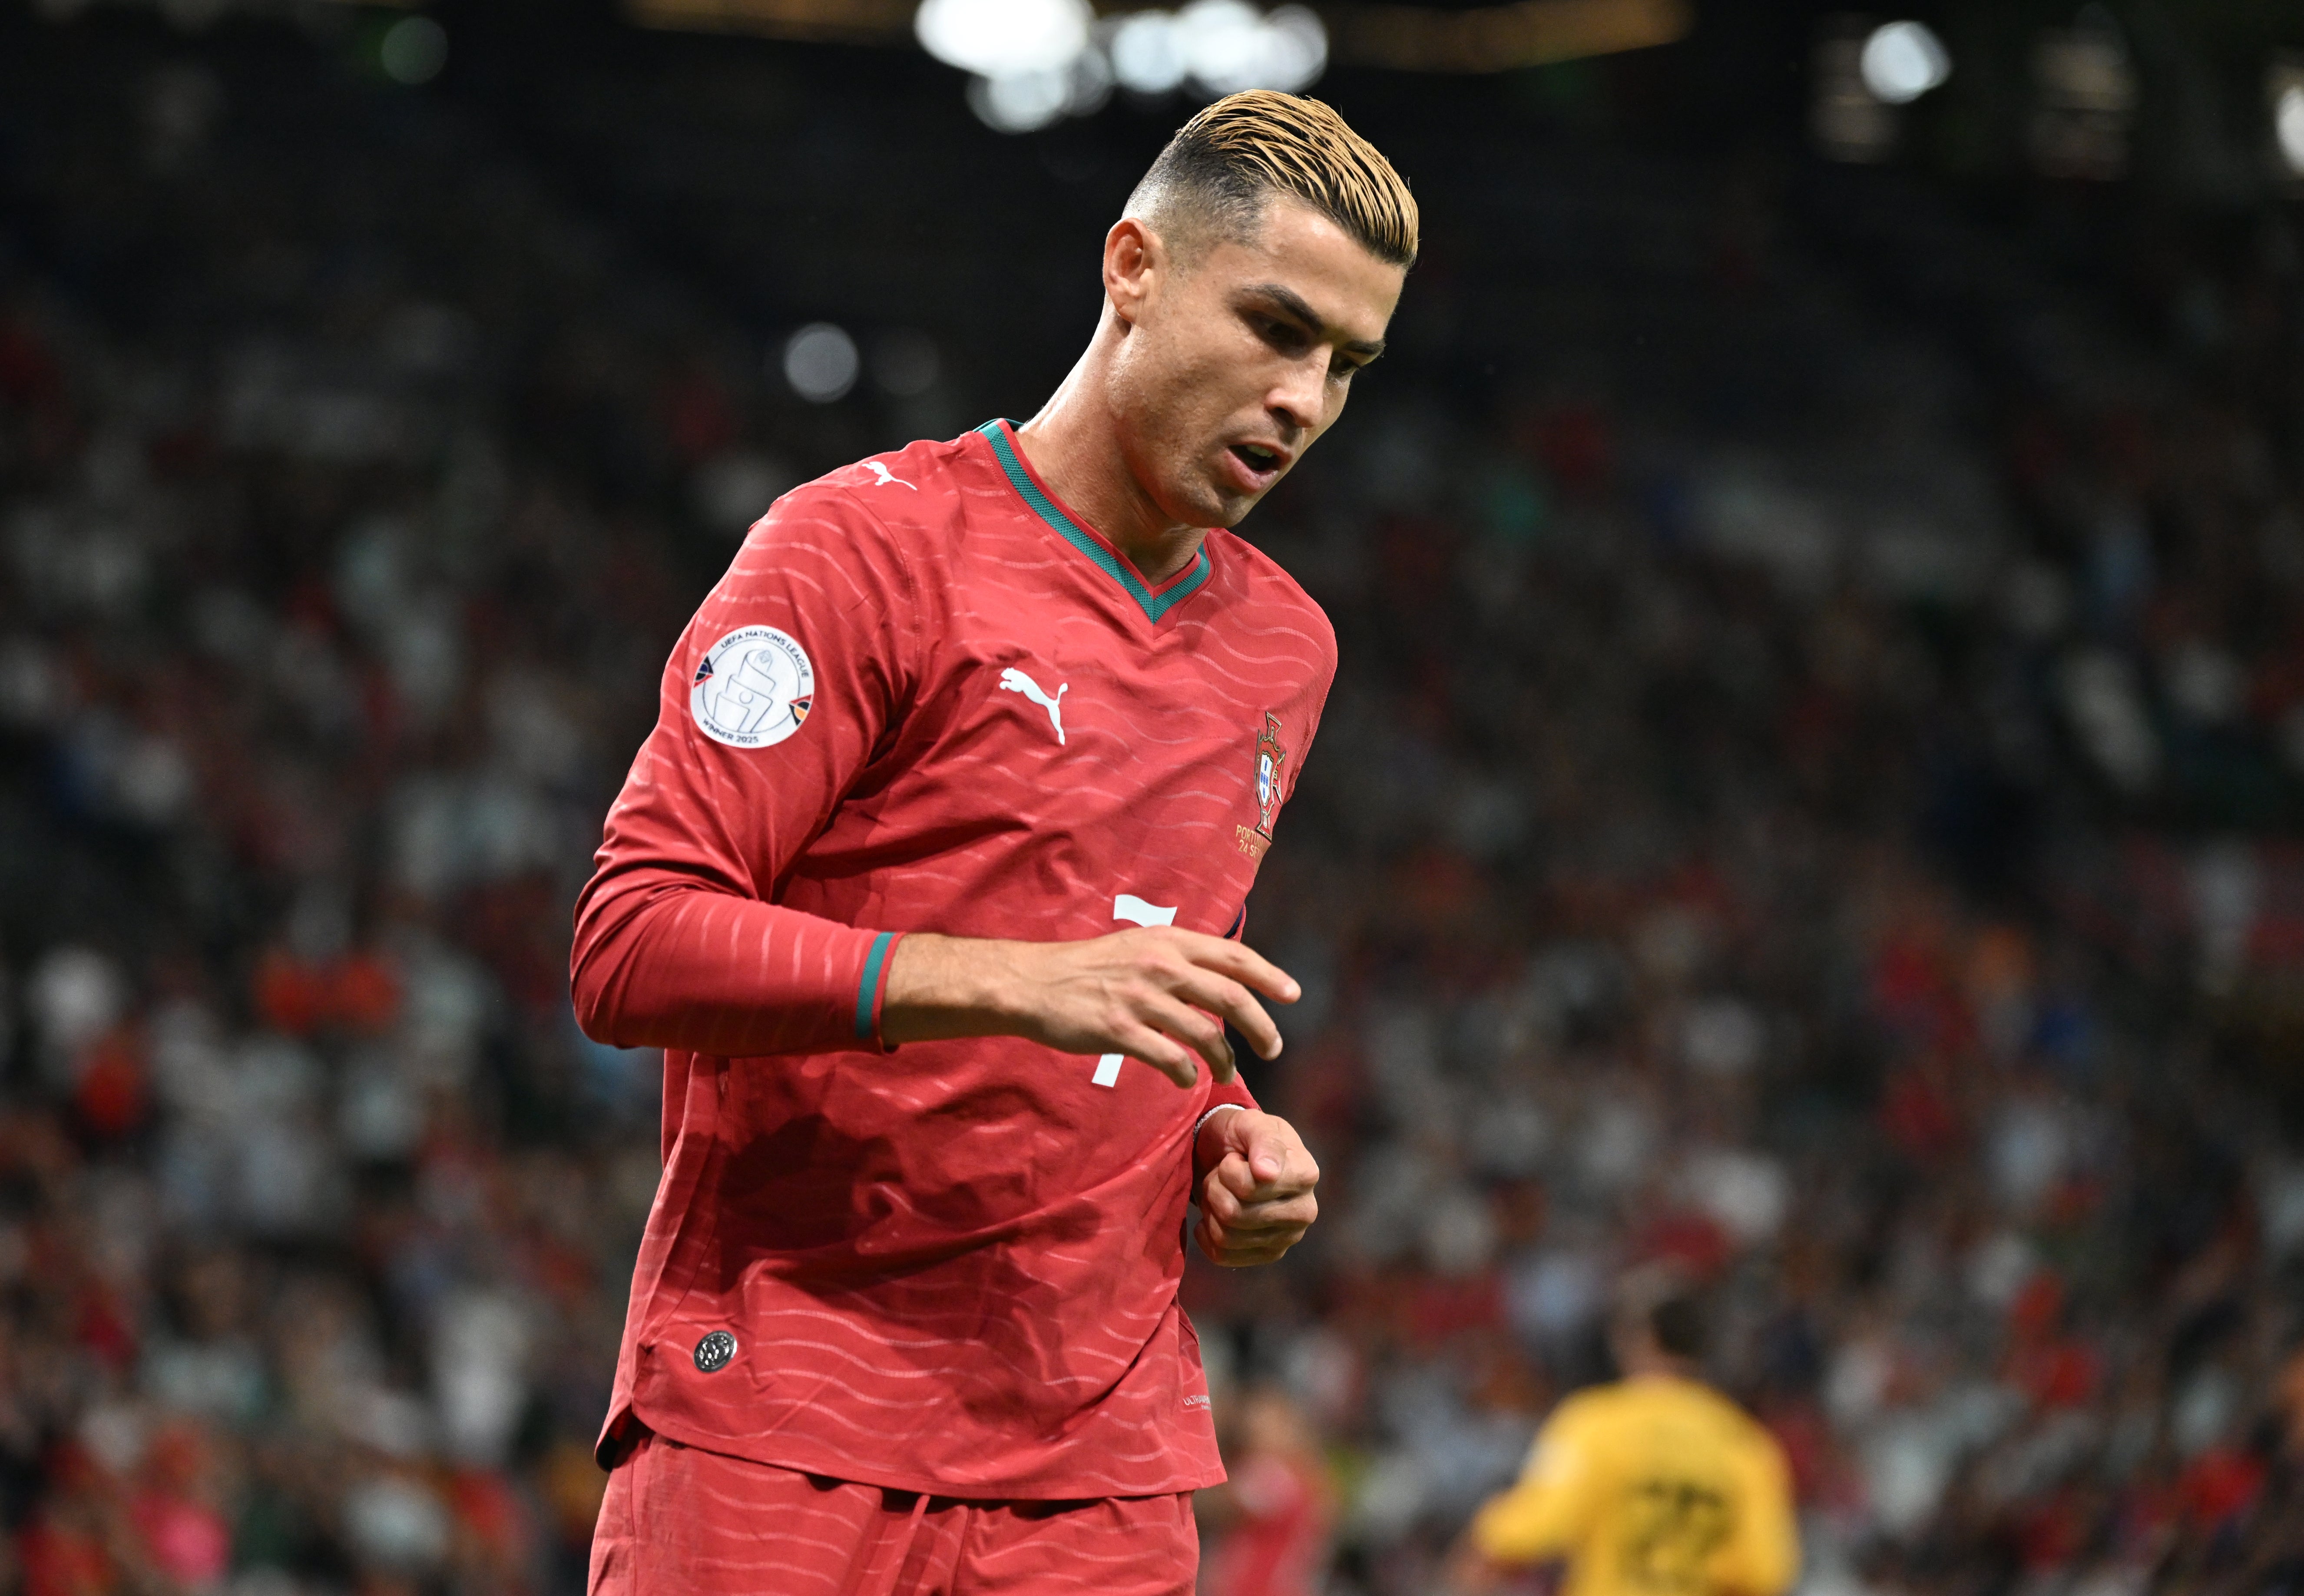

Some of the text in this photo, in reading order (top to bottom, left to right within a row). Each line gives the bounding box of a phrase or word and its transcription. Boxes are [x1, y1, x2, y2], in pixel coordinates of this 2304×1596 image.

[721, 631, 809, 677] UEFA NATIONS LEAGUE
[703, 718, 758, 743] WINNER 2025
